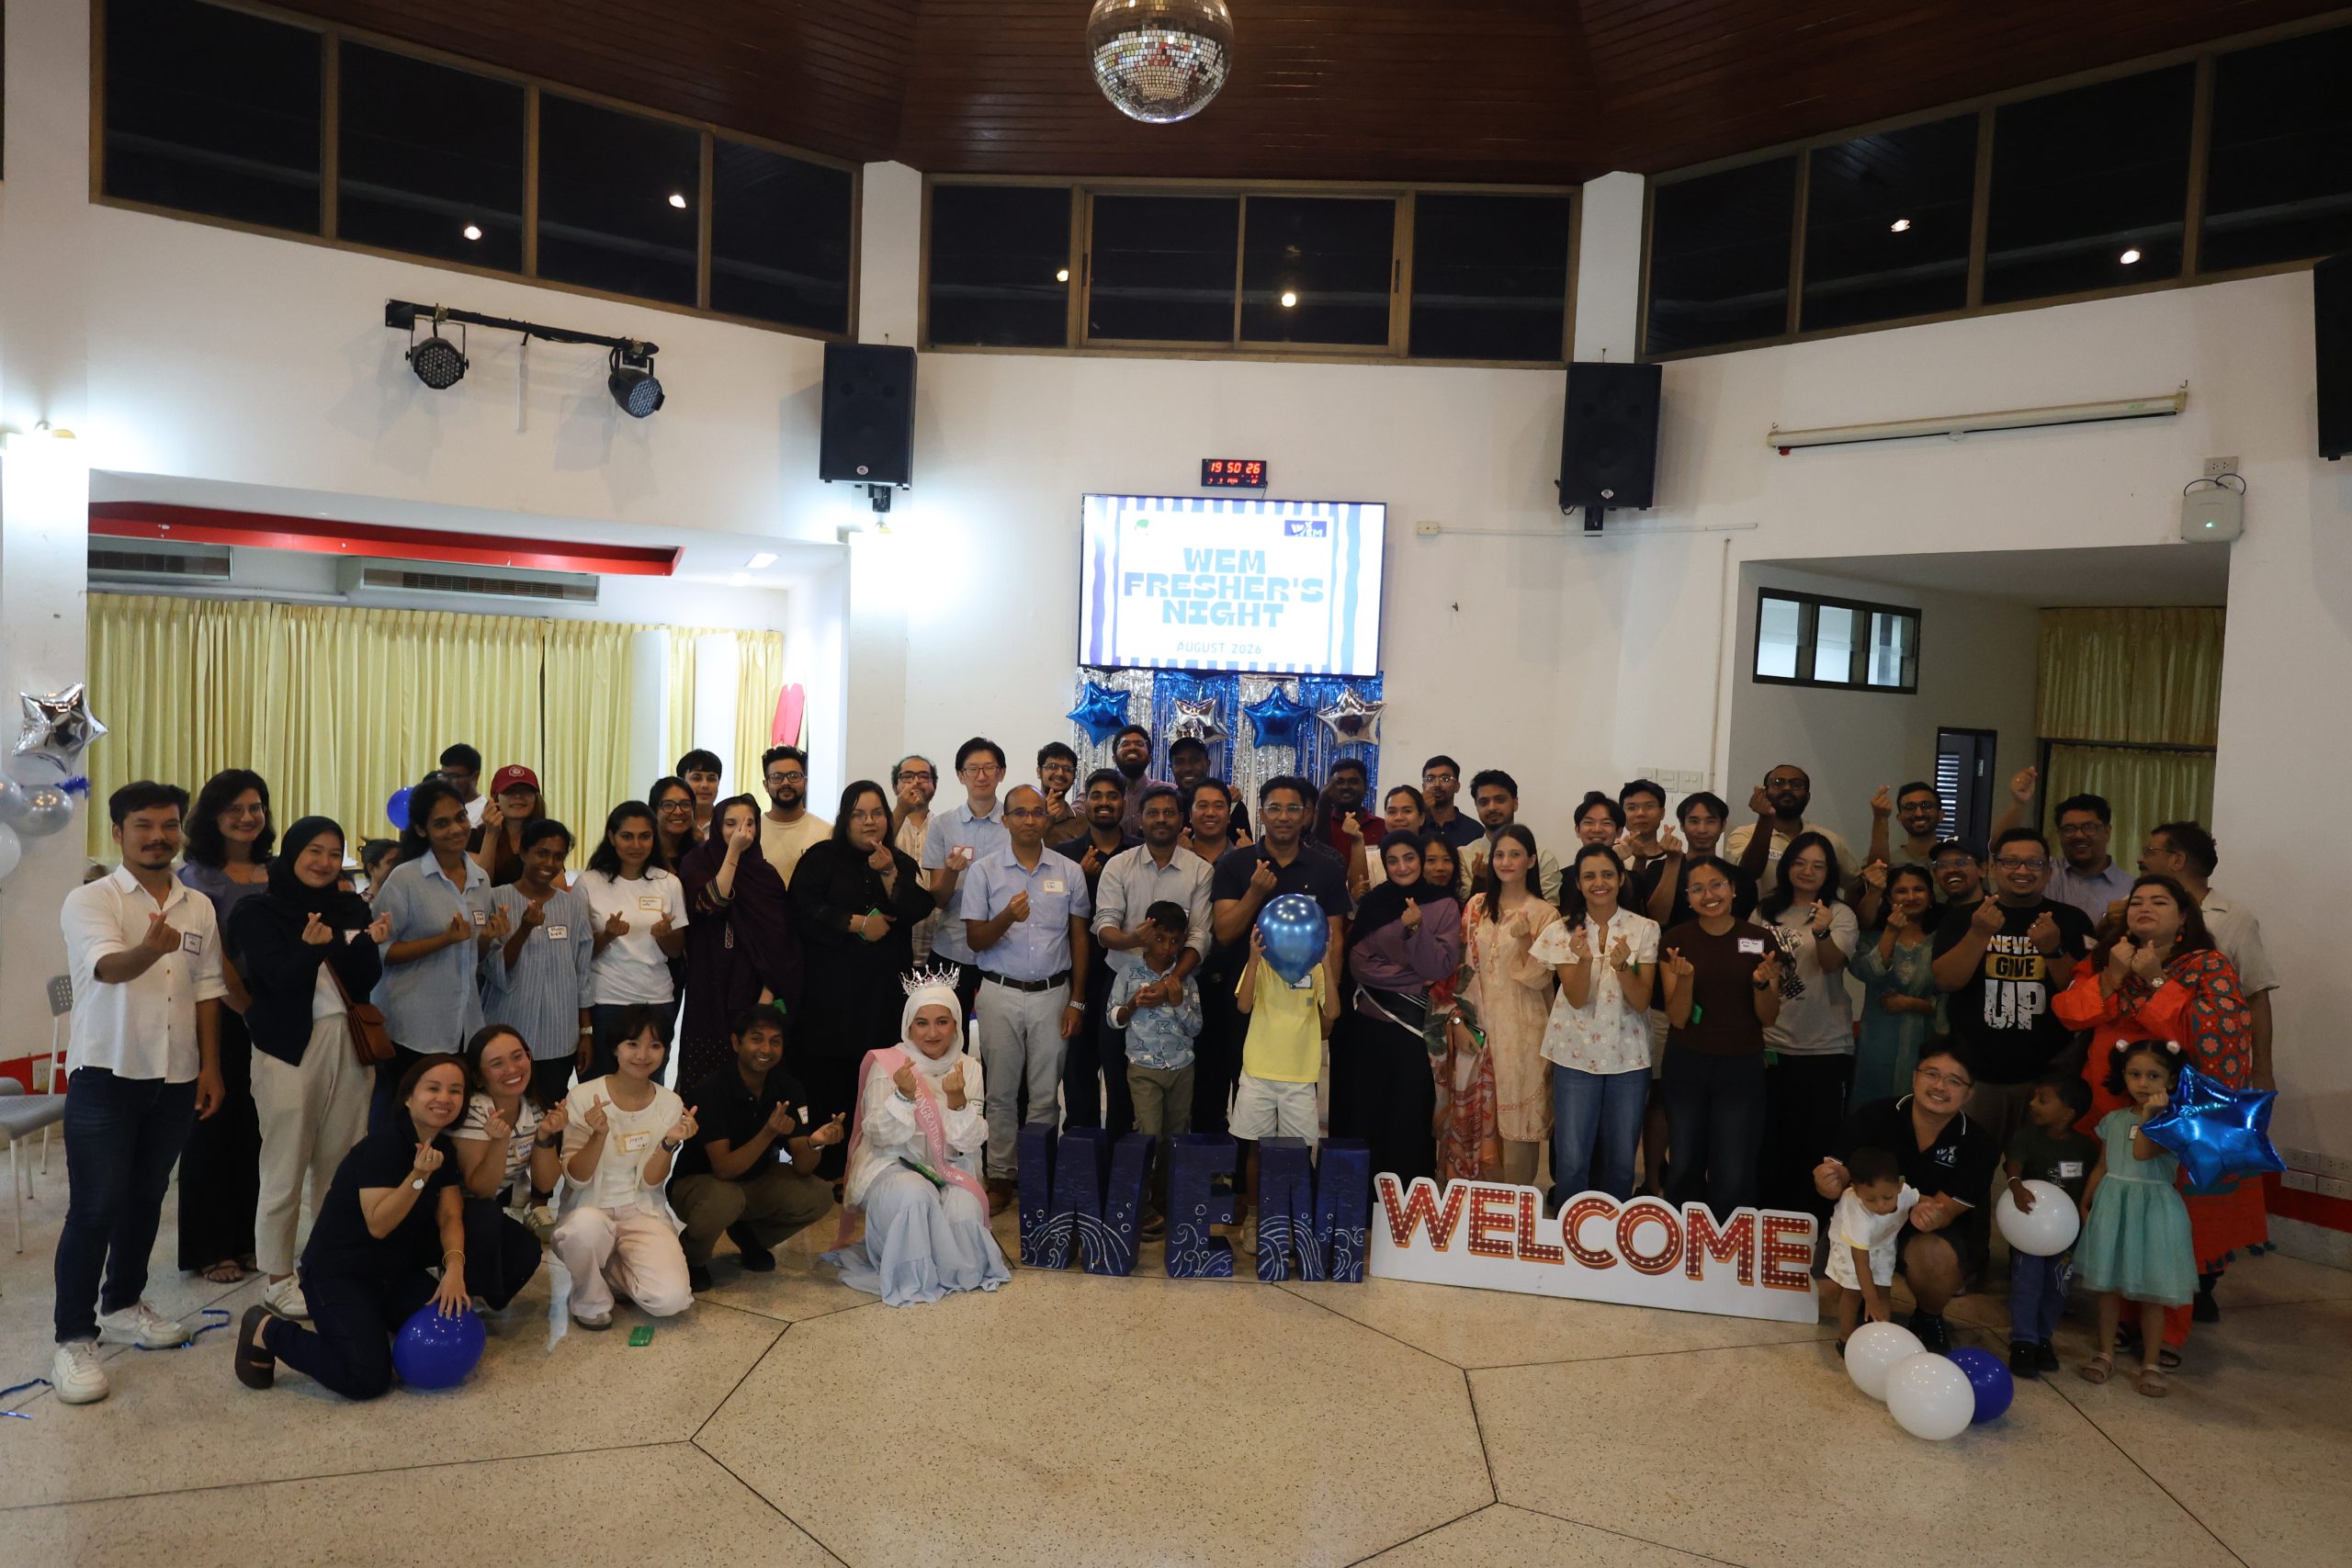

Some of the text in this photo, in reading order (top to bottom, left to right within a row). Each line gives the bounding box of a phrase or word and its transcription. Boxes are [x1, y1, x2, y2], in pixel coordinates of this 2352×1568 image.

[1210, 461, 1261, 474] 19 50 26
[1183, 547, 1266, 574] WEM
[1124, 572, 1324, 604] FRESHER'S
[1162, 600, 1283, 627] NIGHT
[1177, 641, 1261, 654] AUGUST 2026
[1996, 956, 2036, 977] GIVE
[1984, 978, 2047, 1031] UP
[1017, 1122, 1370, 1283] WEM
[1379, 1177, 1812, 1292] WELCOME
